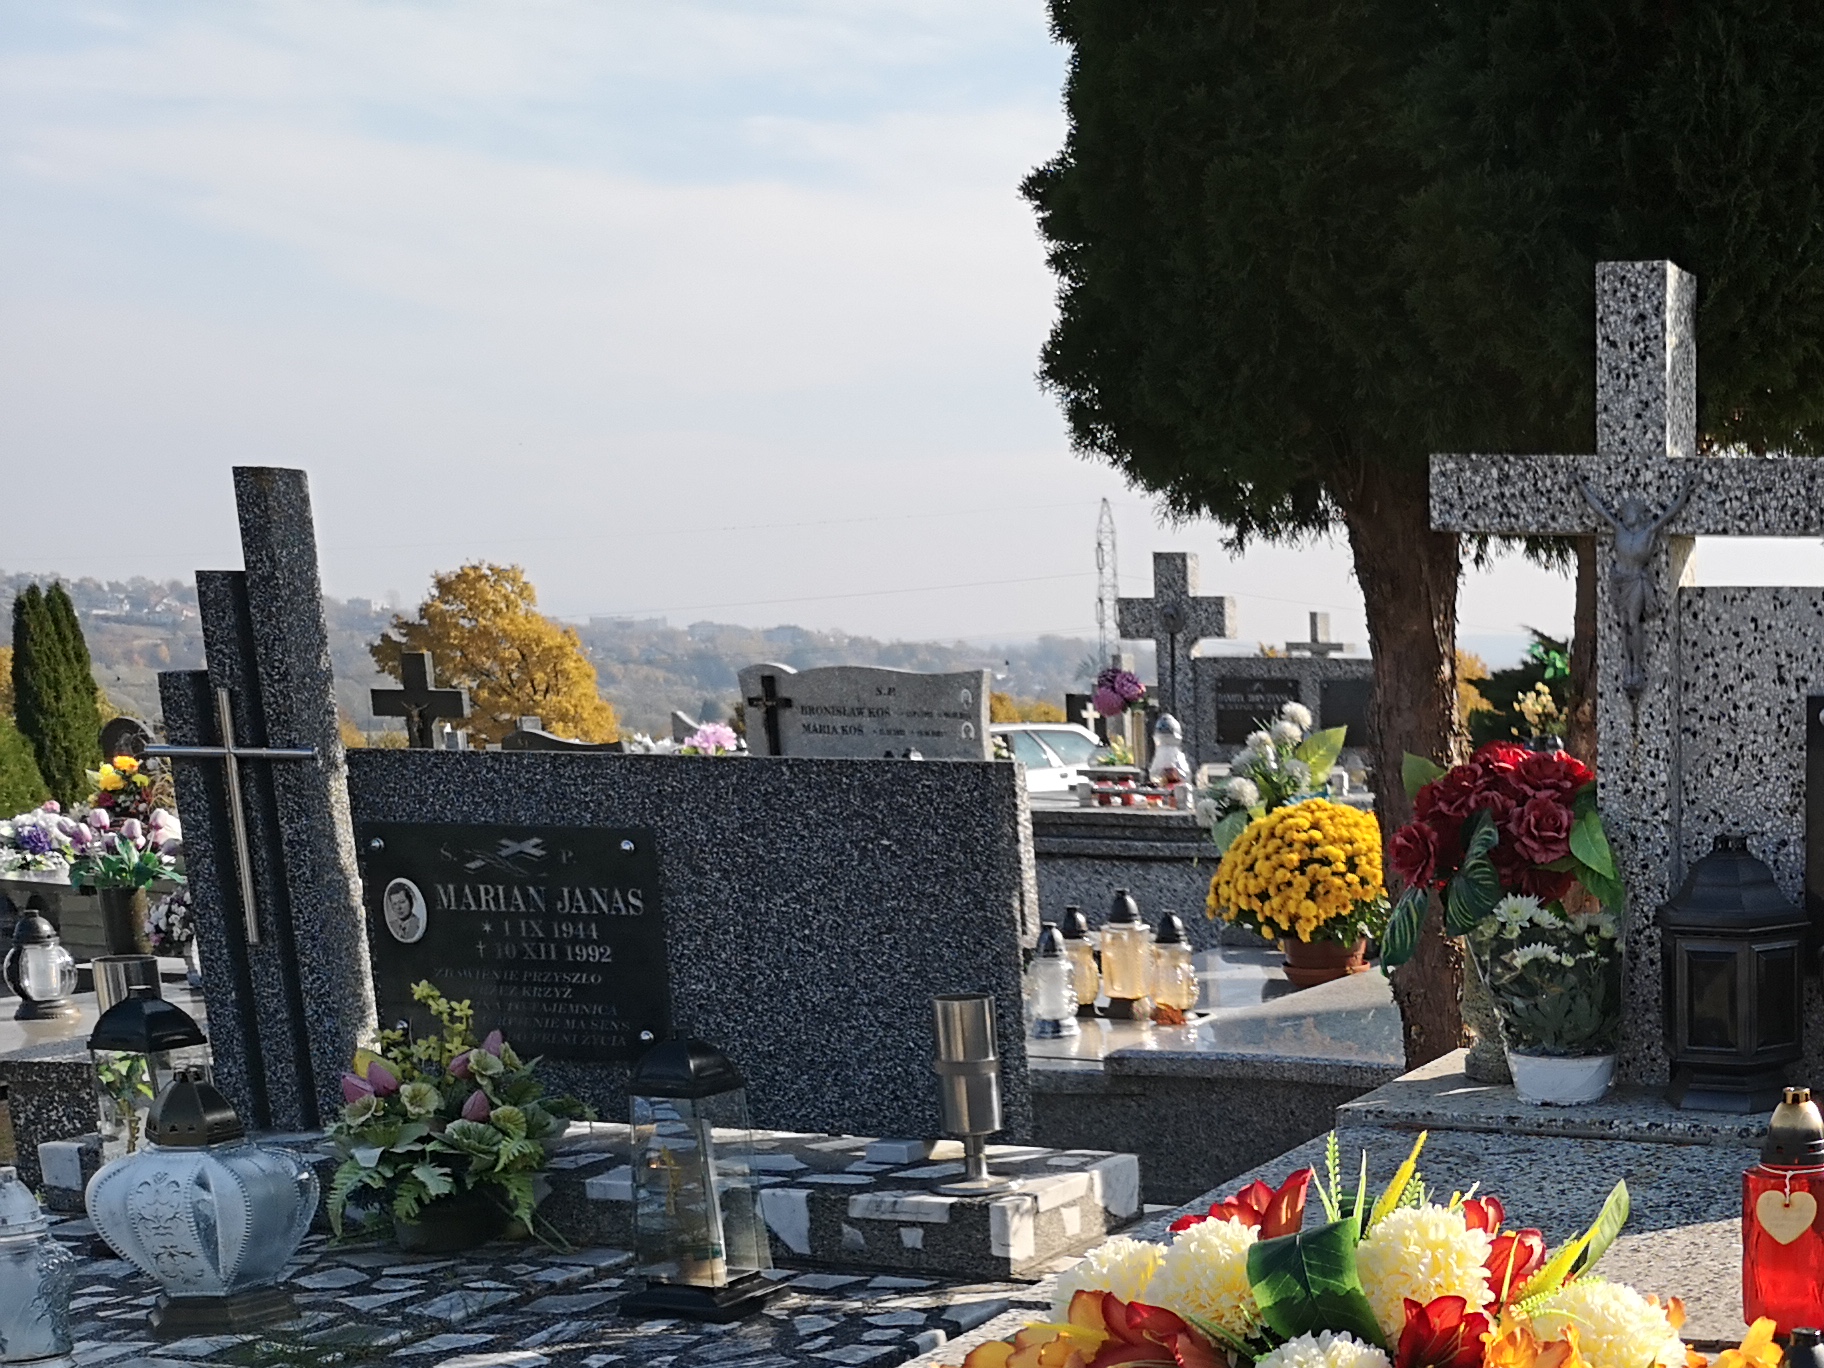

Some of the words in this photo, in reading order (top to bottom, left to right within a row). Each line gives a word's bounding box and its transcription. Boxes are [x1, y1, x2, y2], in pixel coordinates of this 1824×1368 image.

[802, 723, 838, 735] MARIA
[435, 883, 546, 912] MARIAN
[557, 886, 645, 916] JANAS
[520, 919, 545, 938] IX
[552, 921, 599, 940] 1944
[523, 942, 557, 961] XII
[566, 944, 613, 962] 1992
[523, 971, 602, 985] PRZYSZŁO
[522, 984, 573, 999] KRZYŻ
